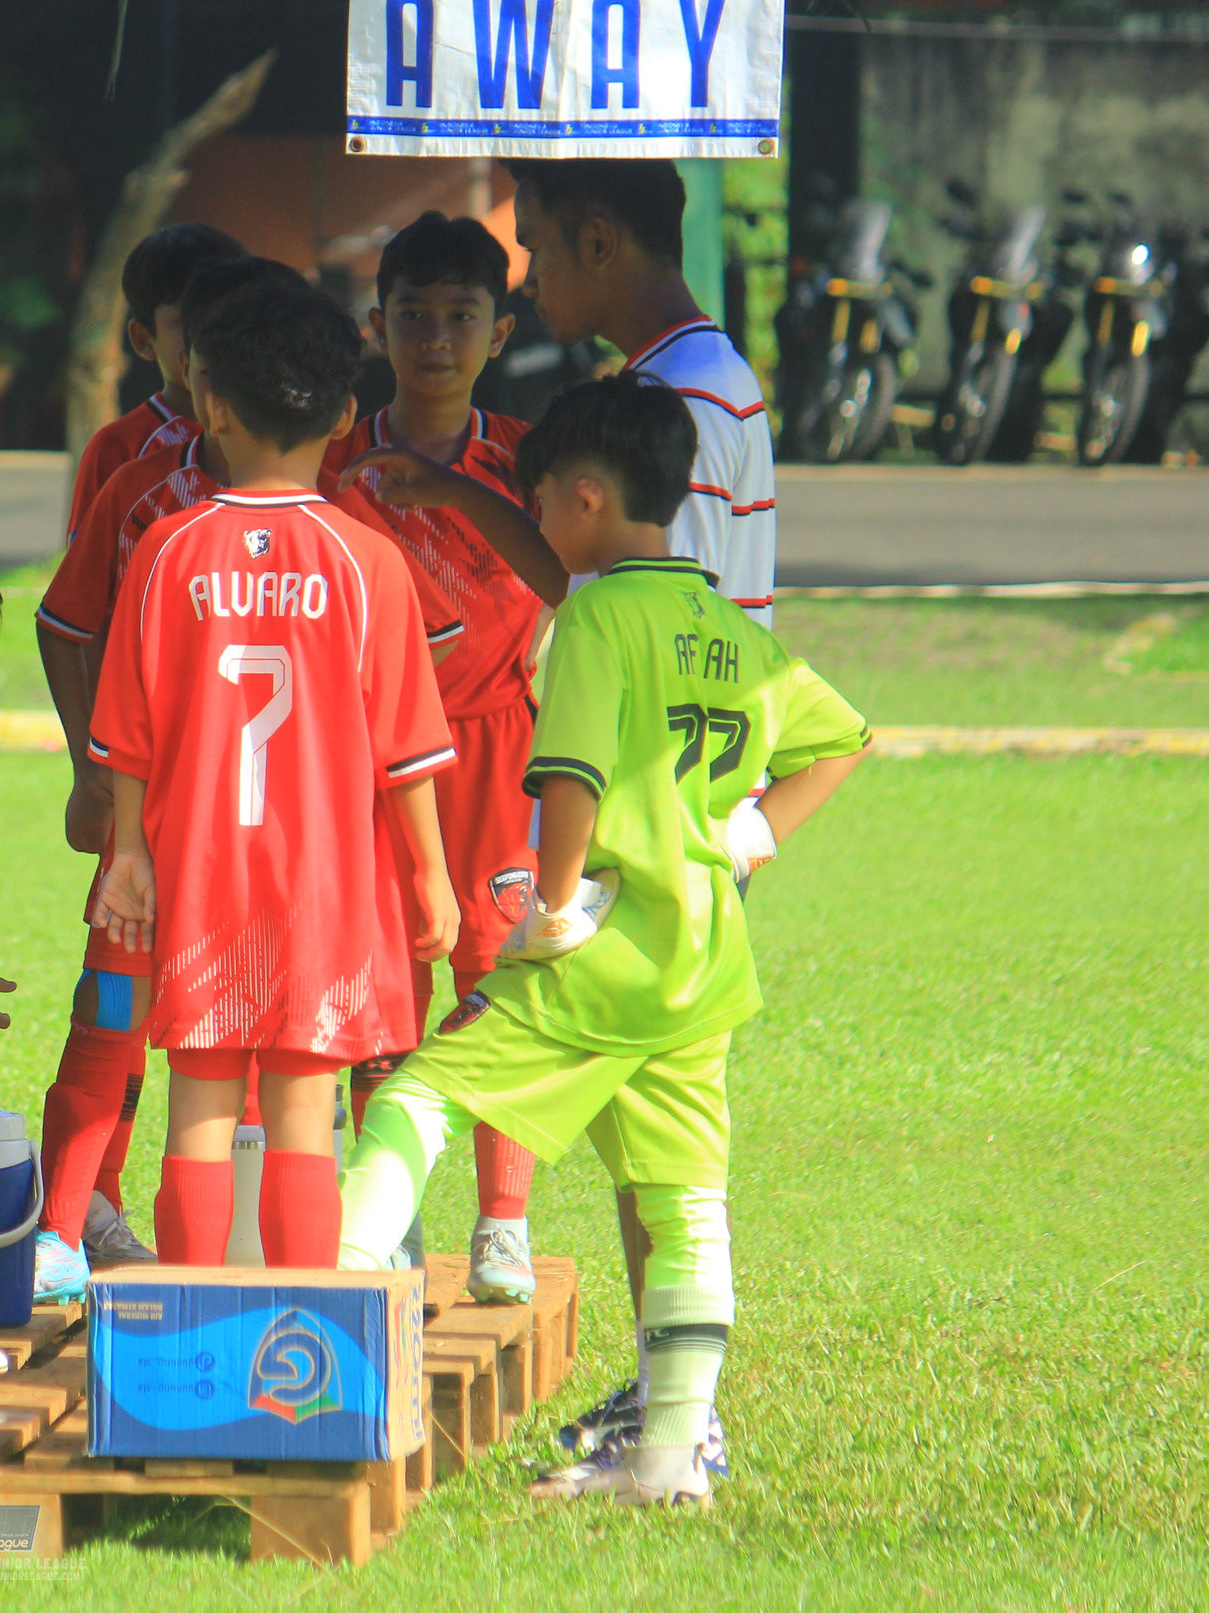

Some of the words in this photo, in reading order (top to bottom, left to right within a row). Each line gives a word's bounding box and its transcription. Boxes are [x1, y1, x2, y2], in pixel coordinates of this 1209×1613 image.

[385, 0, 726, 110] AWAY
[188, 571, 329, 621] ALVARO
[218, 644, 293, 826] 7
[667, 703, 752, 786] 77
